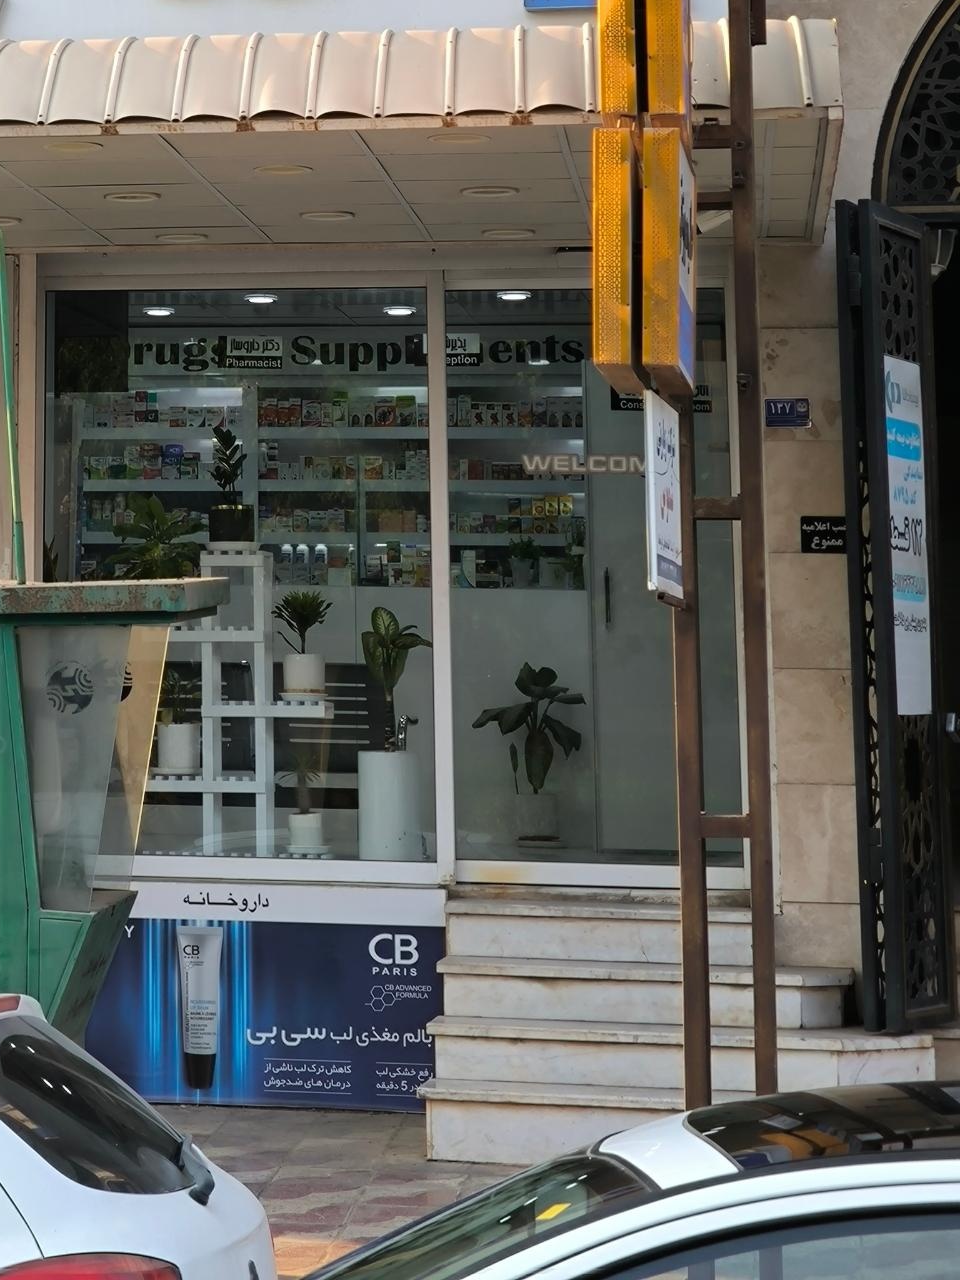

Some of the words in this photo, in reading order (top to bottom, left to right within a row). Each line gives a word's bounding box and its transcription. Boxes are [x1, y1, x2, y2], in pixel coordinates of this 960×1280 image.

[226, 358, 282, 368] Pharmacist
[446, 355, 478, 366] eption
[770, 402, 791, 415] ۱۳۷
[521, 454, 646, 472] WELCOM
[811, 536, 844, 549] ممنوع
[183, 891, 270, 913] داروخانه
[183, 945, 200, 955] CB
[368, 933, 420, 965] CB
[372, 967, 418, 977] PARIS
[395, 984, 432, 992] ADVANCED
[395, 992, 429, 1000] FORMULA
[246, 1026, 277, 1045] بی
[281, 1027, 326, 1046] سی
[330, 1026, 353, 1044] لب
[356, 1026, 399, 1047] مغذی
[403, 1028, 433, 1047] بالم
[264, 1063, 272, 1074] از
[272, 1063, 294, 1074] ناشی
[306, 1064, 325, 1074] ترک
[325, 1064, 352, 1074] کاهش
[376, 1067, 388, 1077] لب
[390, 1067, 416, 1078] خشکی
[304, 1078, 322, 1088] های
[323, 1078, 352, 1090] درمان
[376, 1082, 399, 1091] دقیقه
[401, 1080, 408, 1091] 5
